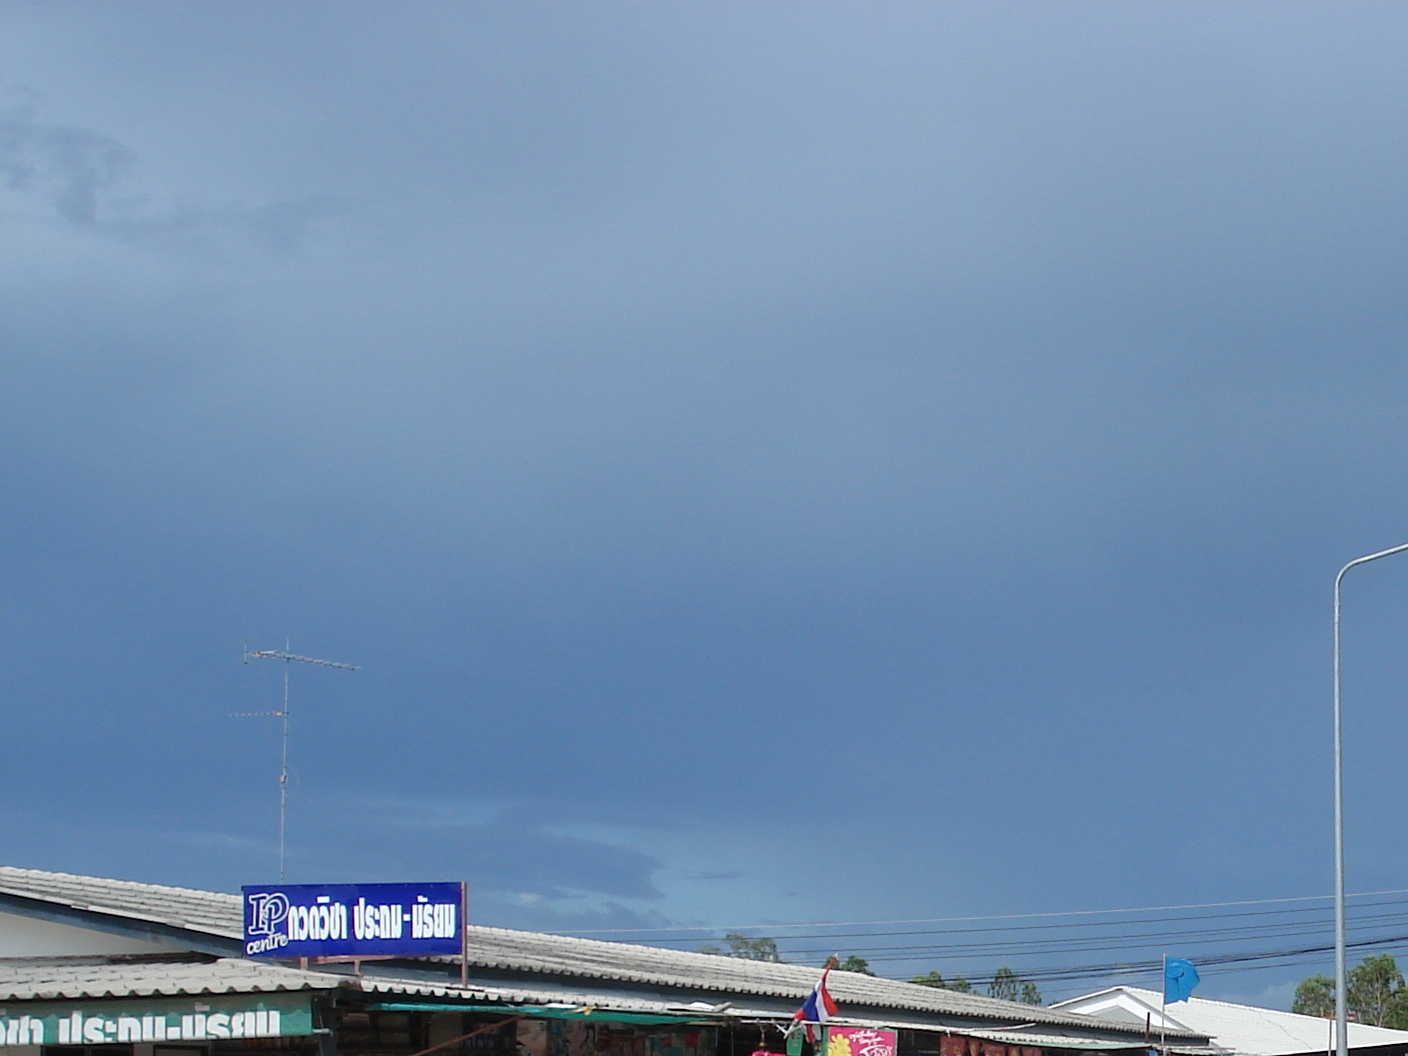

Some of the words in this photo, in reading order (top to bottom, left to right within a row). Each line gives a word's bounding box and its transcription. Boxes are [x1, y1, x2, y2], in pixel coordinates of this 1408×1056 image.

[288, 895, 348, 940] กวดวิชา
[246, 931, 289, 955] centre
